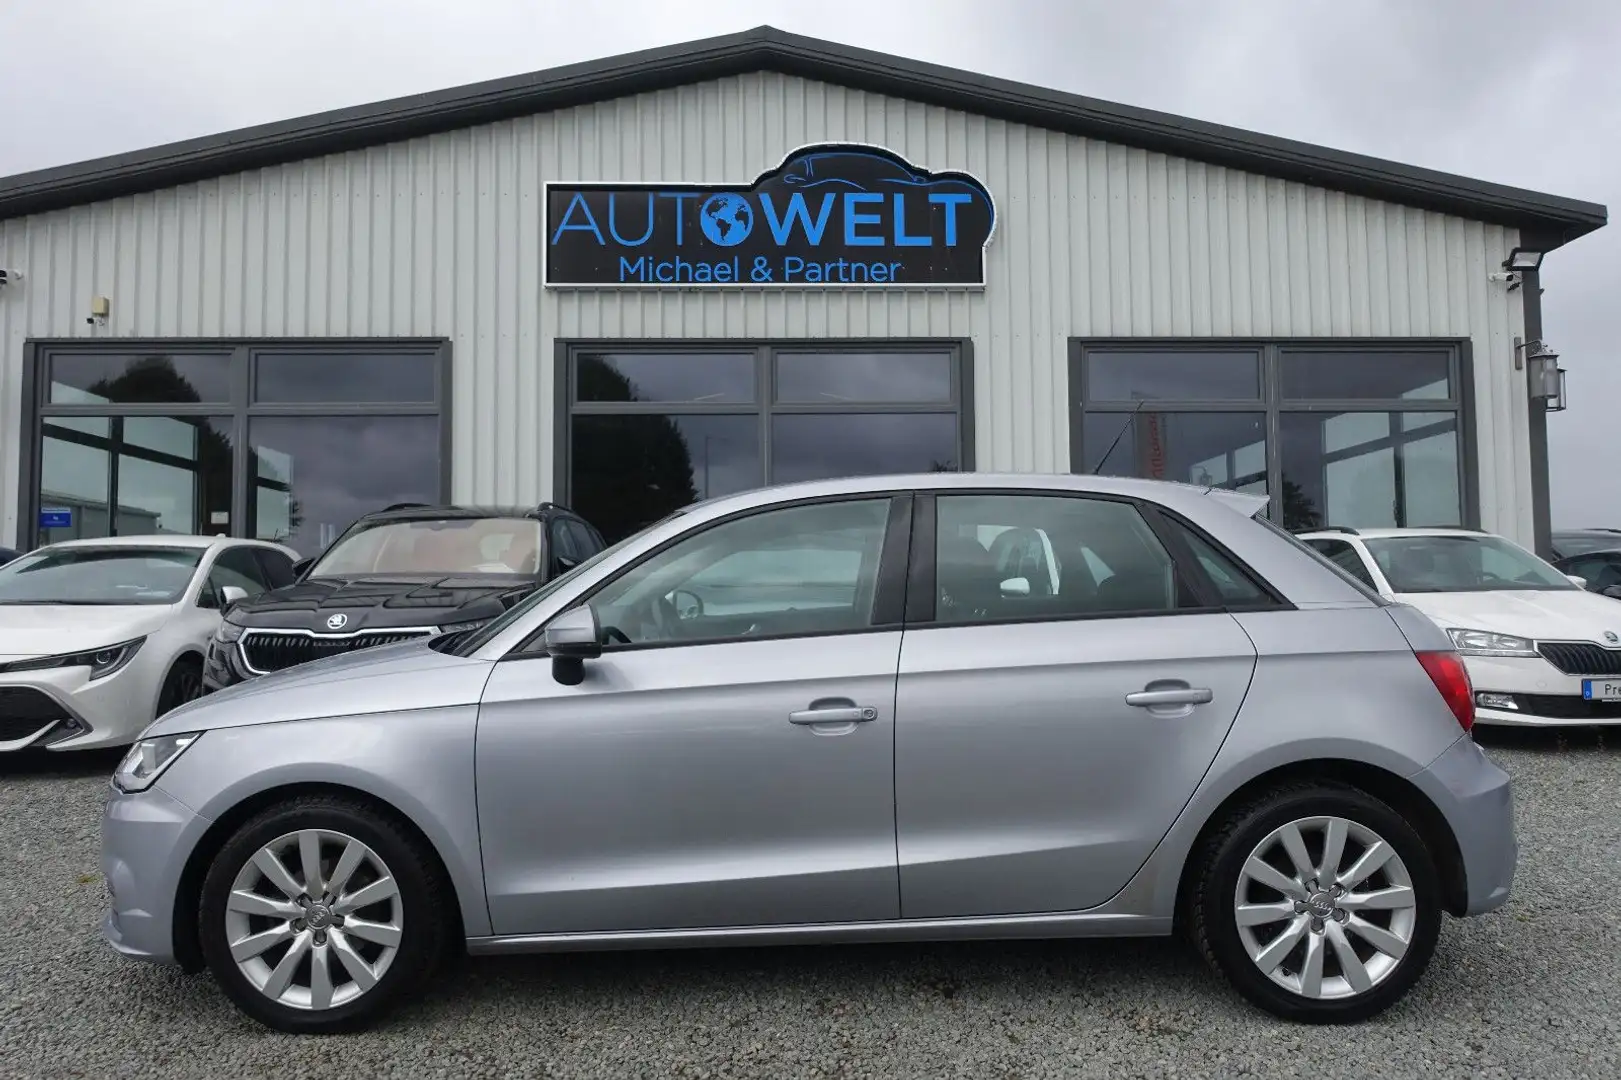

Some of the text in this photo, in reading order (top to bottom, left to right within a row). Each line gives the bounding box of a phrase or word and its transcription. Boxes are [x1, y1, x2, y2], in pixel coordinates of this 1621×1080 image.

[618, 255, 901, 283] Michael & Partner
